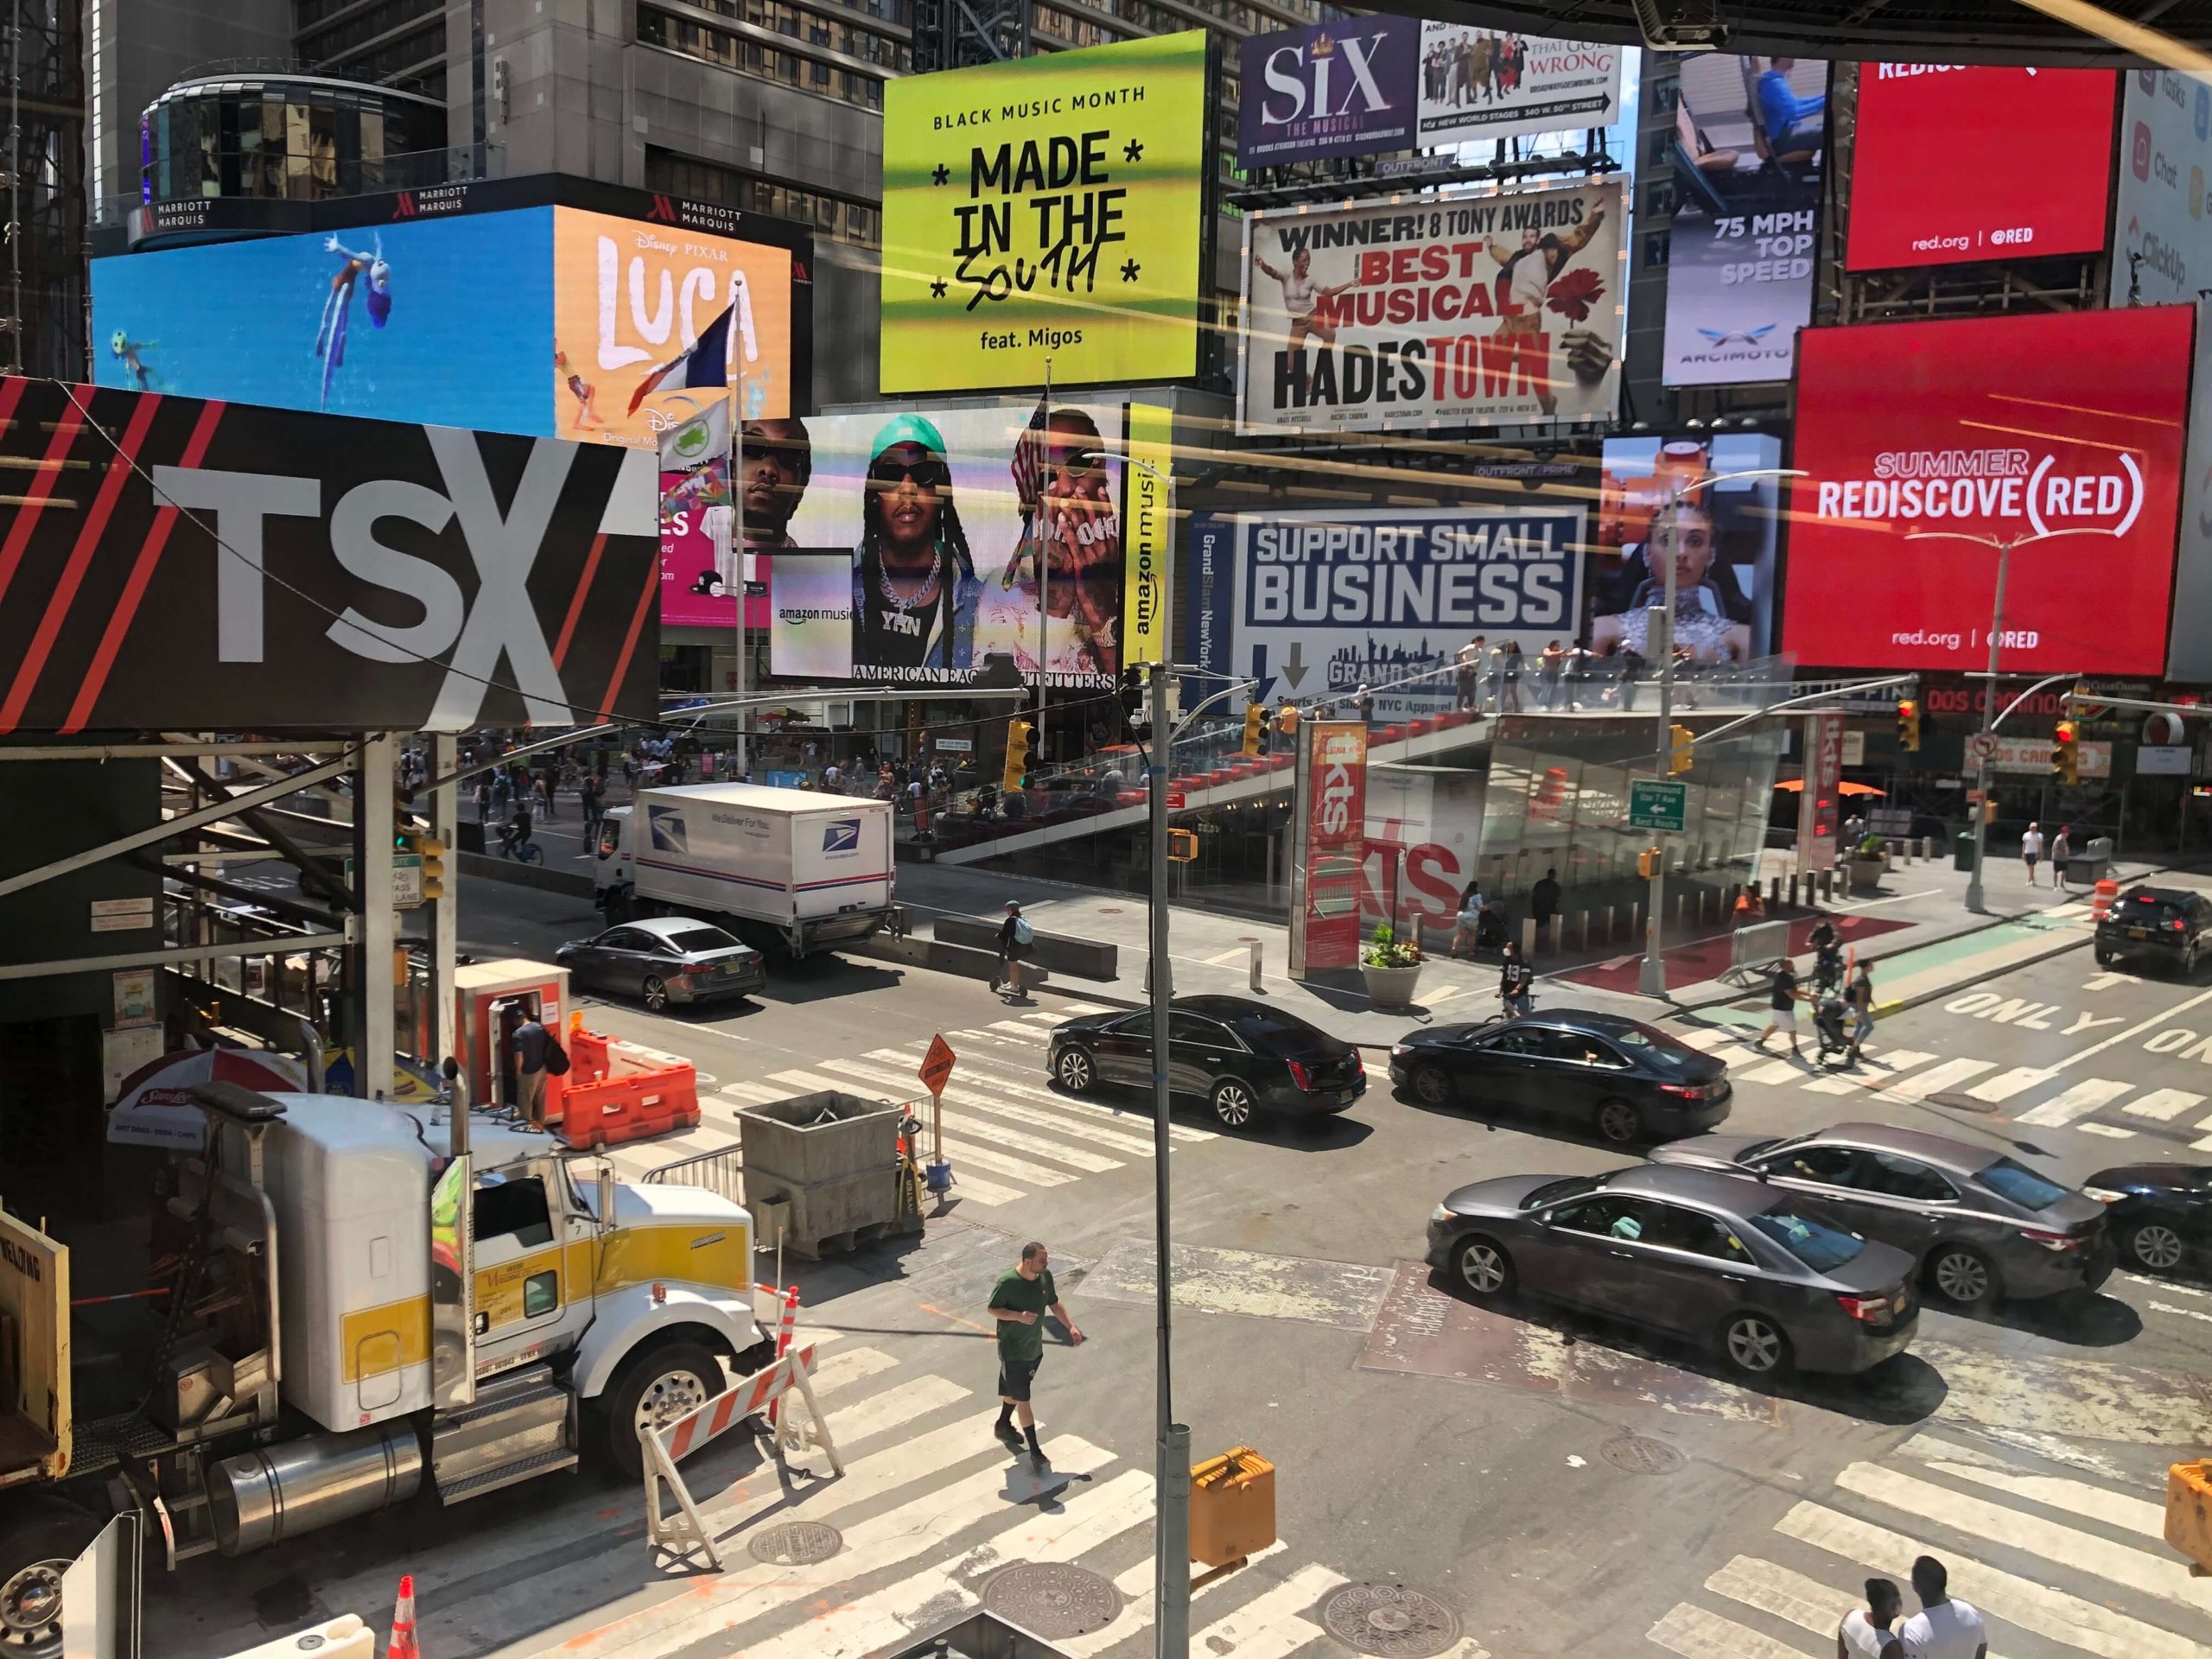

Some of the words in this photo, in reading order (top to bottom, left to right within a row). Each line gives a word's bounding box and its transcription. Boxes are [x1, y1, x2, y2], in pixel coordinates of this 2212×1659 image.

[1425, 22, 1446, 33] AND
[1530, 41, 1563, 54] THAT
[1529, 50, 1614, 75] WRONG
[1262, 32, 1394, 125] SIX
[933, 108, 992, 130] BLACK
[1001, 98, 1063, 120] MUSIC
[1071, 86, 1147, 111] MONTH
[1438, 116, 1458, 127] NEW
[1458, 112, 1489, 124] WORLD
[1489, 110, 1519, 121] STAGES
[1523, 107, 1541, 118] 340
[1571, 100, 1604, 111] STREET
[1286, 122, 1306, 137] THE
[1313, 115, 1365, 134] MUSICAL
[970, 130, 1111, 199] MADE
[1382, 156, 1450, 173] OUTFRONT
[2154, 151, 2177, 190] Chat
[418, 186, 468, 200] MARRIOTT
[418, 199, 463, 213] MARQUIS
[157, 200, 212, 214] MARRIOTT
[158, 213, 205, 227] MARQUIS
[682, 200, 742, 221] MARRIOTT
[682, 213, 734, 232] MARQUIS
[952, 201, 1011, 257] IN
[1029, 188, 1128, 250] THE
[1279, 215, 1424, 253] WINNER!
[1430, 215, 1441, 237] 8
[1446, 207, 1497, 235] TONY
[1501, 197, 1586, 232] AWARDS
[1714, 216, 1746, 239] 75
[1752, 211, 1815, 236] MPH
[632, 229, 677, 255] Disney
[684, 244, 728, 263] PIXAR
[1755, 235, 1814, 258] TOP
[1912, 232, 1970, 252] red.org
[1990, 226, 2034, 245] @RED
[954, 232, 1103, 312] SOUTH
[1359, 240, 1486, 286] BEST
[1719, 259, 1811, 285] SPEED
[597, 235, 759, 371] LUCA
[1314, 282, 1526, 329] MUSICAL
[981, 330, 1021, 350] feat.
[1027, 327, 1084, 350] Migos
[1680, 346, 1789, 365] ARCIMOTO
[1273, 331, 1550, 409] HADESTOWN
[1873, 448, 2031, 479] SUMMER
[1140, 457, 1156, 541] music
[1255, 525, 1424, 562] SUPPORT
[1430, 523, 1566, 562] SMALL
[152, 423, 575, 734] TSX
[1135, 556, 1153, 637] amazon
[1253, 563, 1563, 623] BUSINESS
[779, 607, 819, 620] amazon
[1891, 630, 1961, 651] red.org
[852, 664, 950, 683] AMERICAN
[1378, 699, 1402, 711] NYC
[1928, 690, 1968, 710] DOS
[1943, 992, 2126, 1036] ONLY
